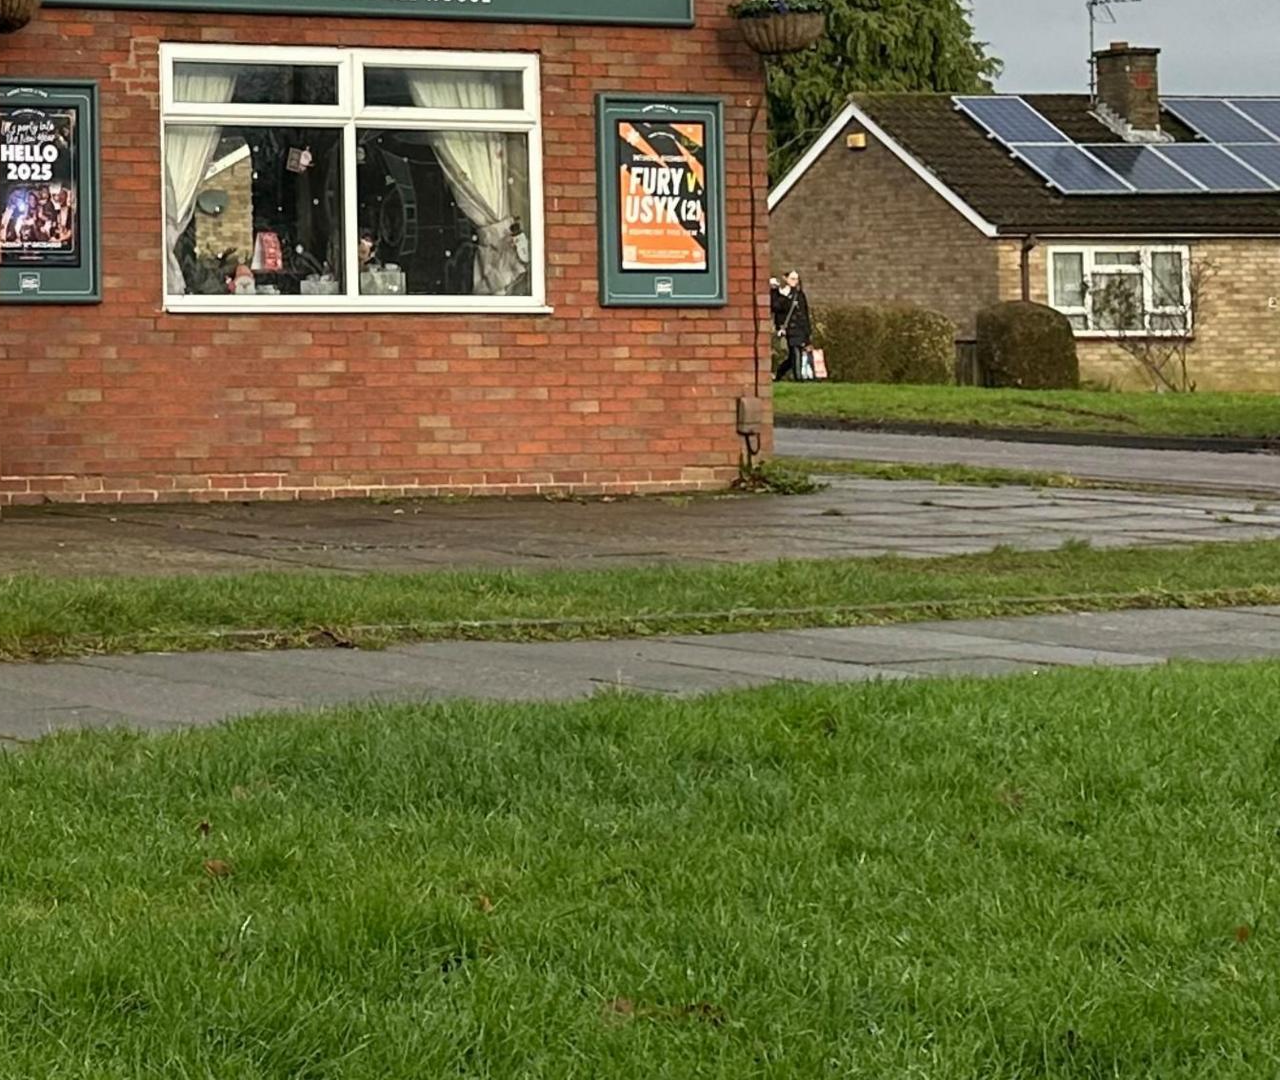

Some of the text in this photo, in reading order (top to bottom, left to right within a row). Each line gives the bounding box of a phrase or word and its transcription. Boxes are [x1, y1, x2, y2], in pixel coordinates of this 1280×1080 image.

[0, 144, 59, 163] HELLO
[7, 163, 53, 180] 2025
[629, 166, 684, 196] FURY
[625, 195, 702, 224] USYK (2)
